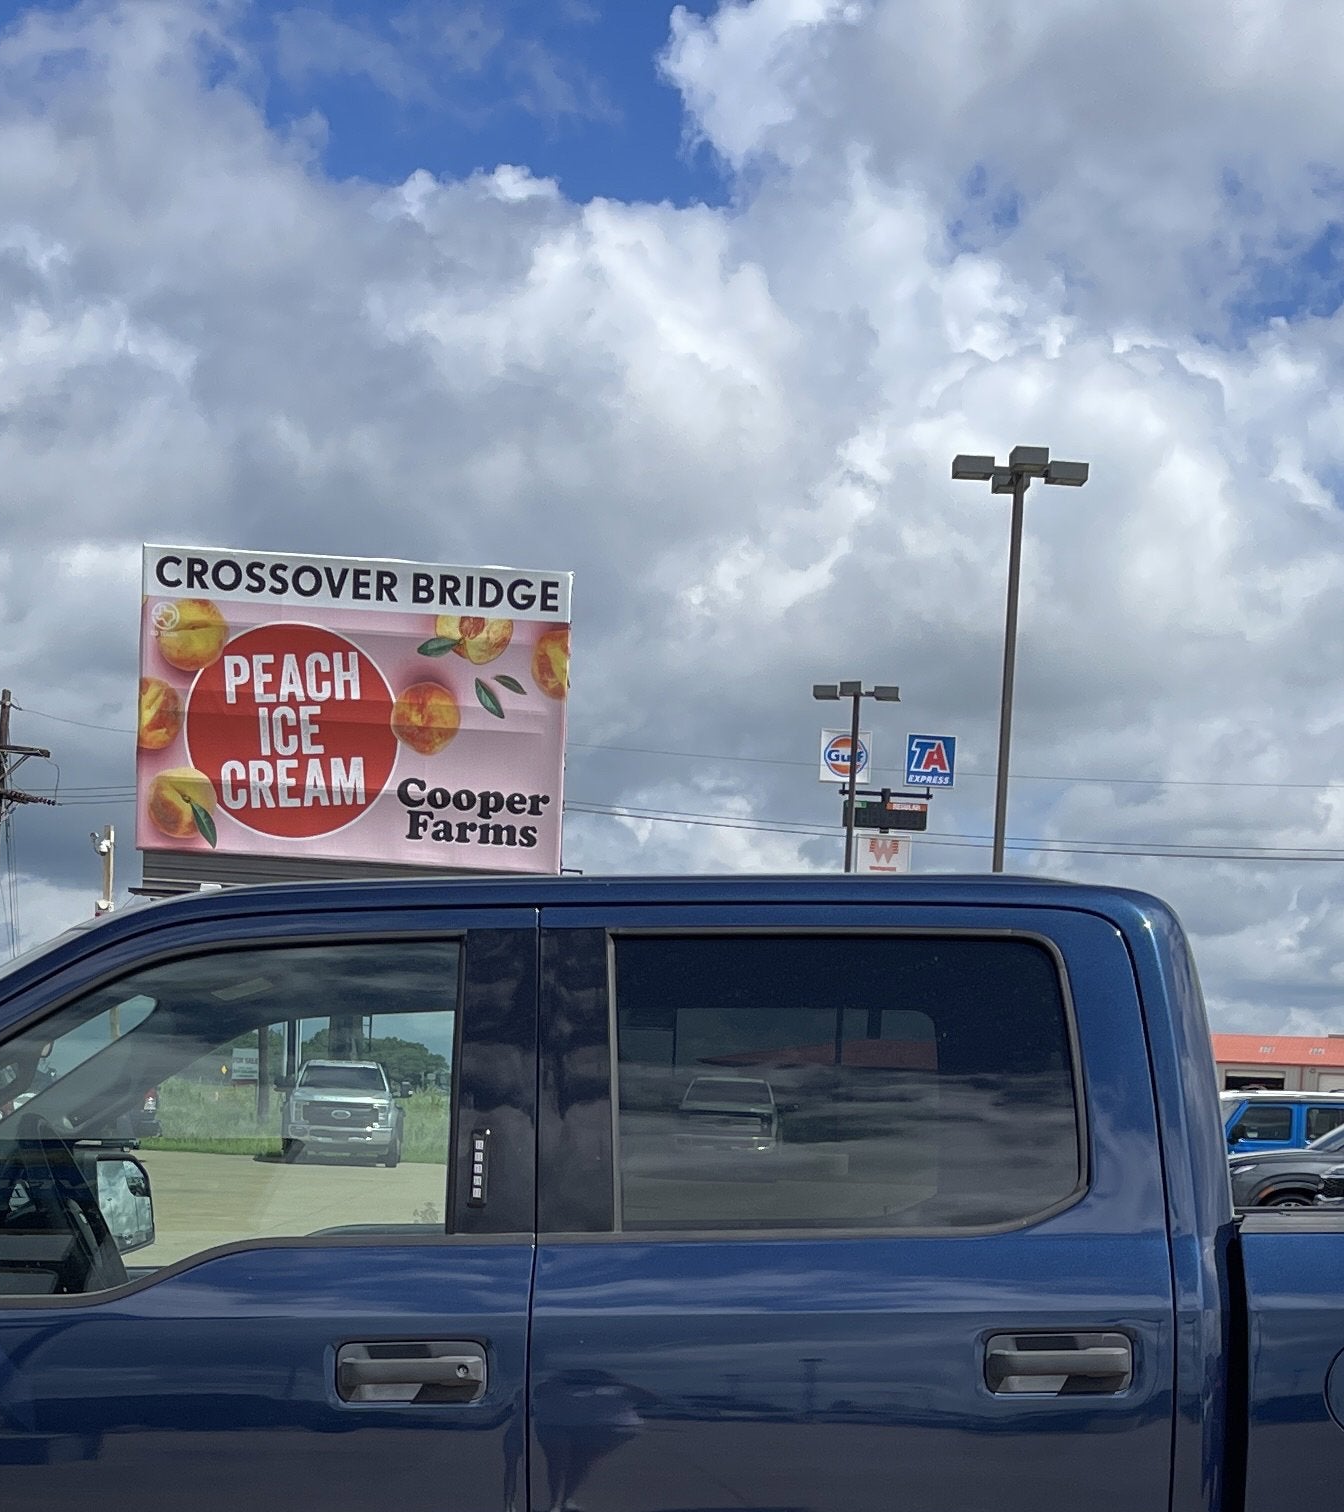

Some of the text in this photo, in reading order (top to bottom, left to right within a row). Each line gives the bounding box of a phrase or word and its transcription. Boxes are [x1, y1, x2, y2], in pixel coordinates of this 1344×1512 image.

[155, 555, 560, 613] CROSSOVER BRIDGE
[224, 652, 361, 705] PEACH
[258, 706, 324, 757] ICE
[828, 749, 864, 762] Guf
[911, 739, 950, 773] TA
[220, 757, 366, 811] CREAM
[396, 778, 551, 821] Cooper
[908, 774, 949, 785] EXPRESS
[406, 810, 538, 848] Farms
